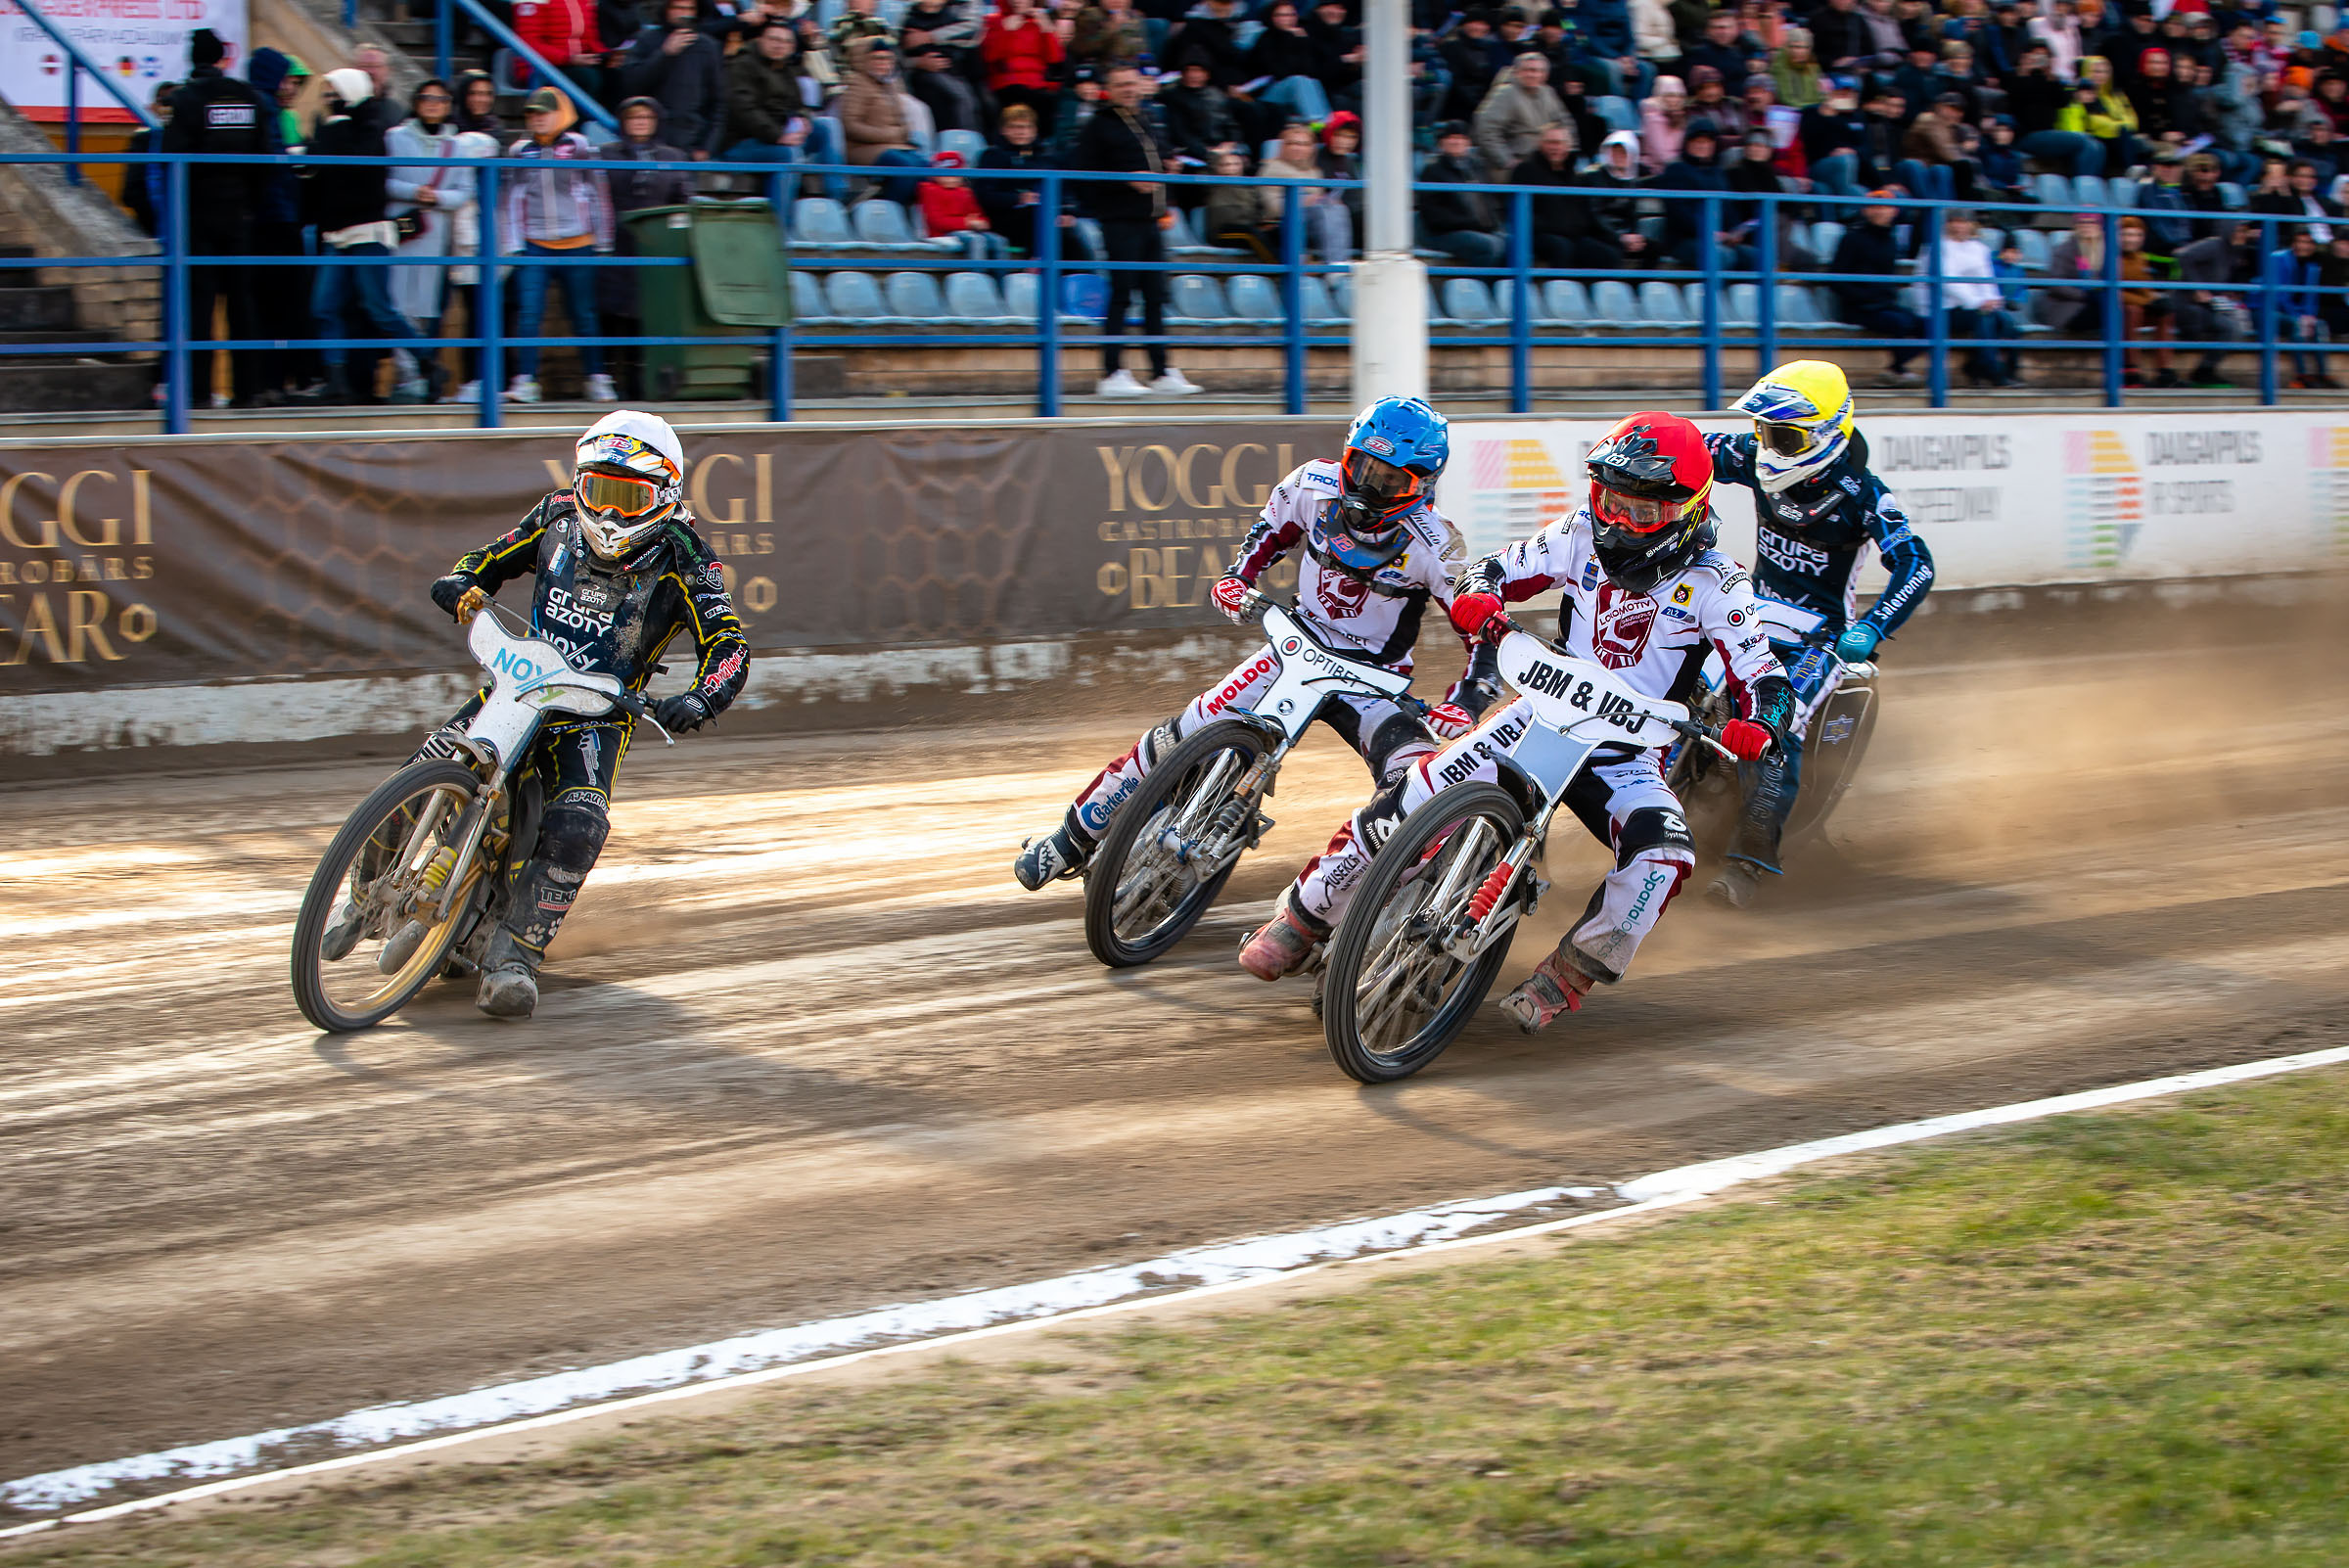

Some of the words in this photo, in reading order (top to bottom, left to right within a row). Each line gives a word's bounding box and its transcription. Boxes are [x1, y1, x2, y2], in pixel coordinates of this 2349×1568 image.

[1128, 544, 1243, 610] BEA
[1303, 648, 1362, 688] OPTIBET
[1518, 660, 1574, 700] JBM
[1570, 681, 1594, 713] &
[1595, 690, 1651, 734] VBJ
[1439, 751, 1481, 789] JBM
